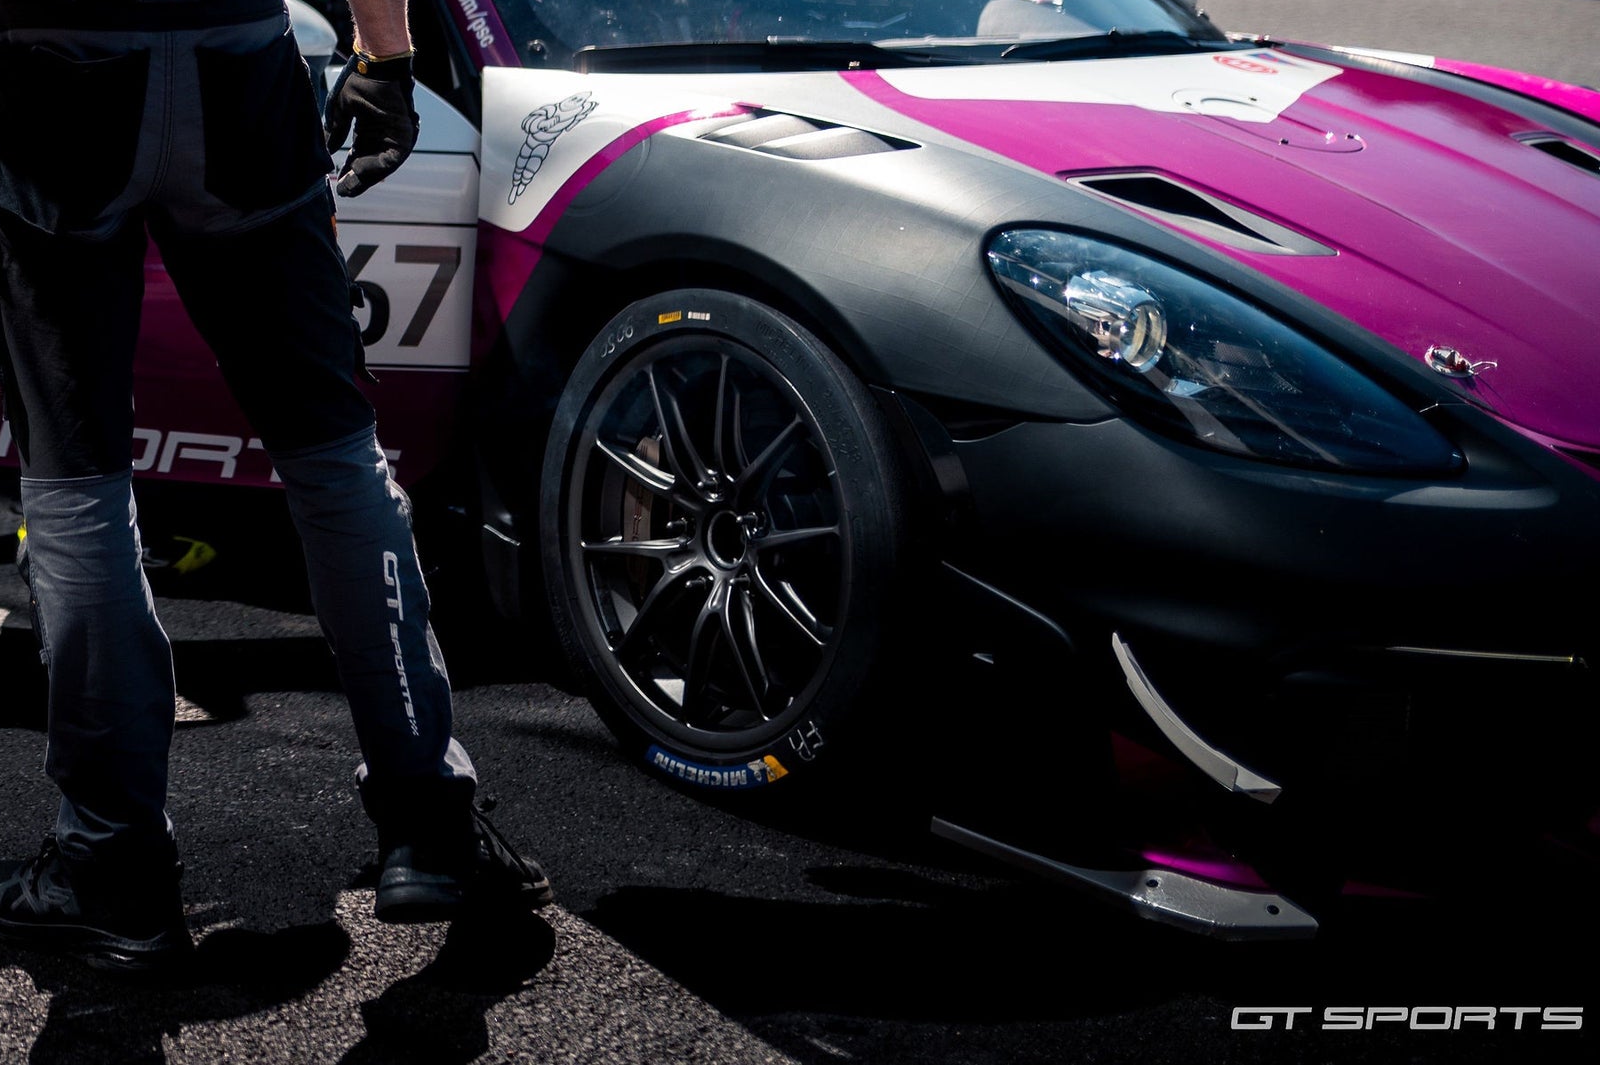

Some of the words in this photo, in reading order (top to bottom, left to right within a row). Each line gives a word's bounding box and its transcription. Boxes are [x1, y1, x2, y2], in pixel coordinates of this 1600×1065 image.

[383, 550, 404, 621] GT
[389, 622, 415, 719] SPORTS
[654, 752, 747, 786] MICHELIN
